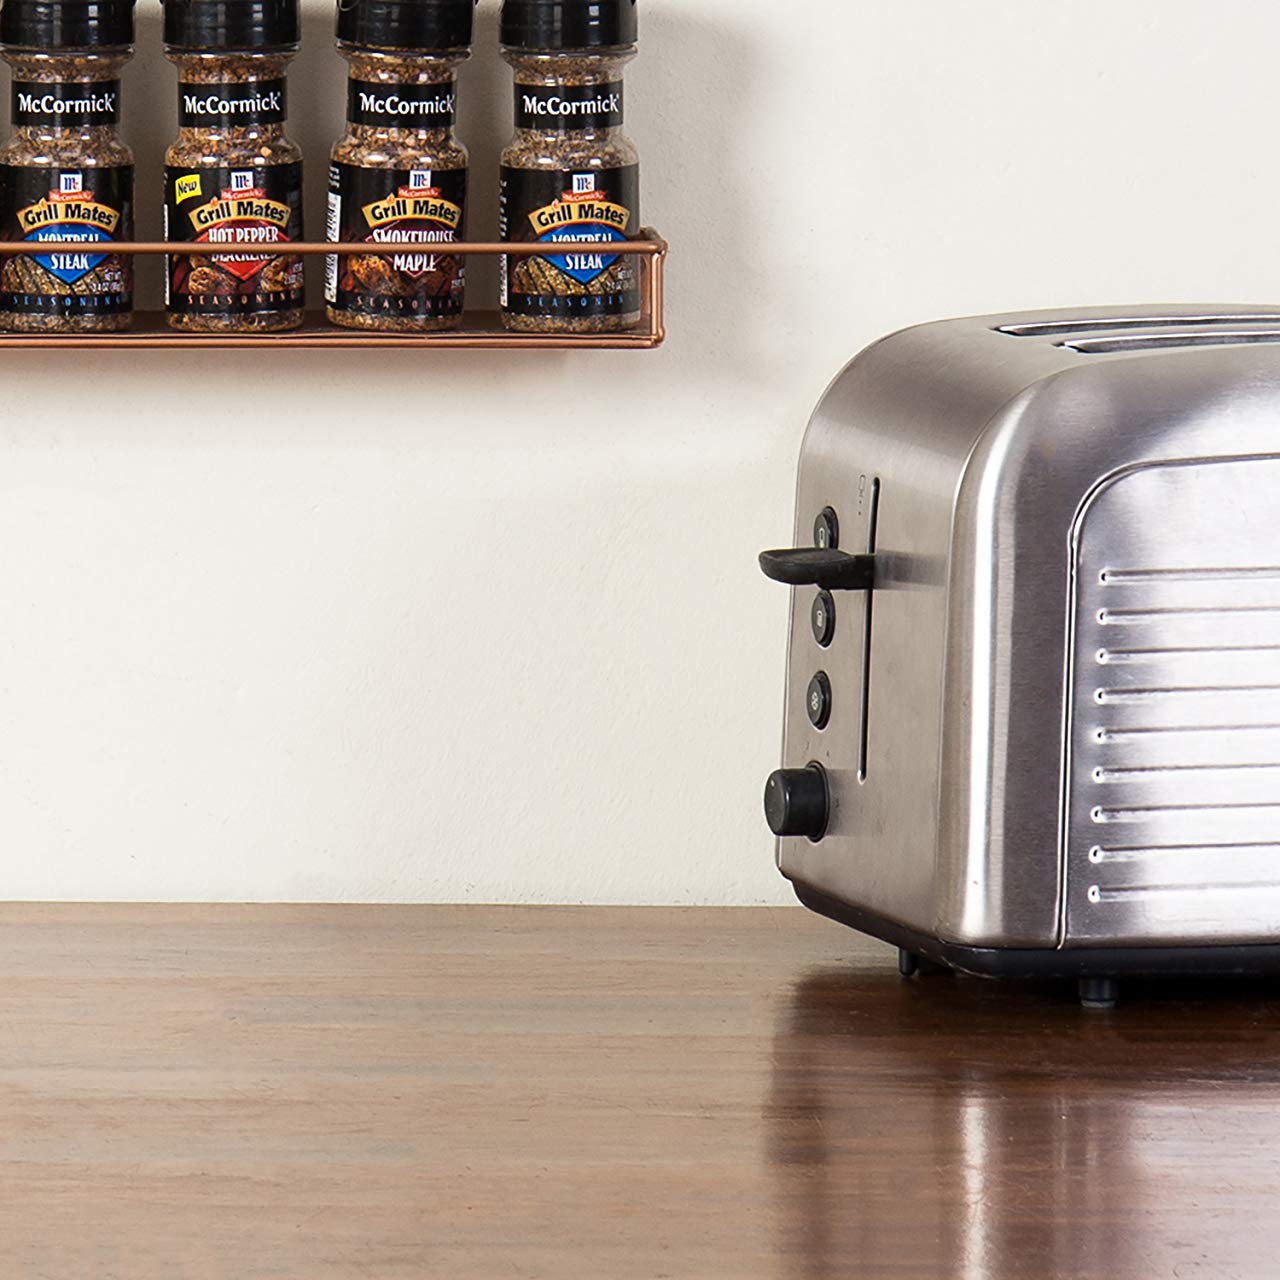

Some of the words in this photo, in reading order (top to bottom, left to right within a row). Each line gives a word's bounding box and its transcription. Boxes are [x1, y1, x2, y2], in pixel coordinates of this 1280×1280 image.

[18, 93, 115, 114] McCormick
[184, 92, 280, 114] McCormick
[359, 92, 455, 114] McCormick
[523, 94, 619, 115] McCormick
[178, 180, 198, 195] New
[24, 203, 59, 225] Grill
[65, 203, 114, 226] Mates
[196, 203, 231, 224] Grill
[237, 201, 286, 222] Mates
[371, 200, 407, 221] Grill
[413, 200, 456, 222] Mates
[536, 204, 573, 227] Grill
[578, 203, 625, 225] Mates
[208, 228, 234, 243] HOT
[236, 226, 279, 243] PEPPER
[372, 229, 455, 243] SMOKEHOUSE
[51, 254, 90, 270] STEAK
[393, 253, 438, 271] MAPLE
[565, 254, 605, 270] STEAK
